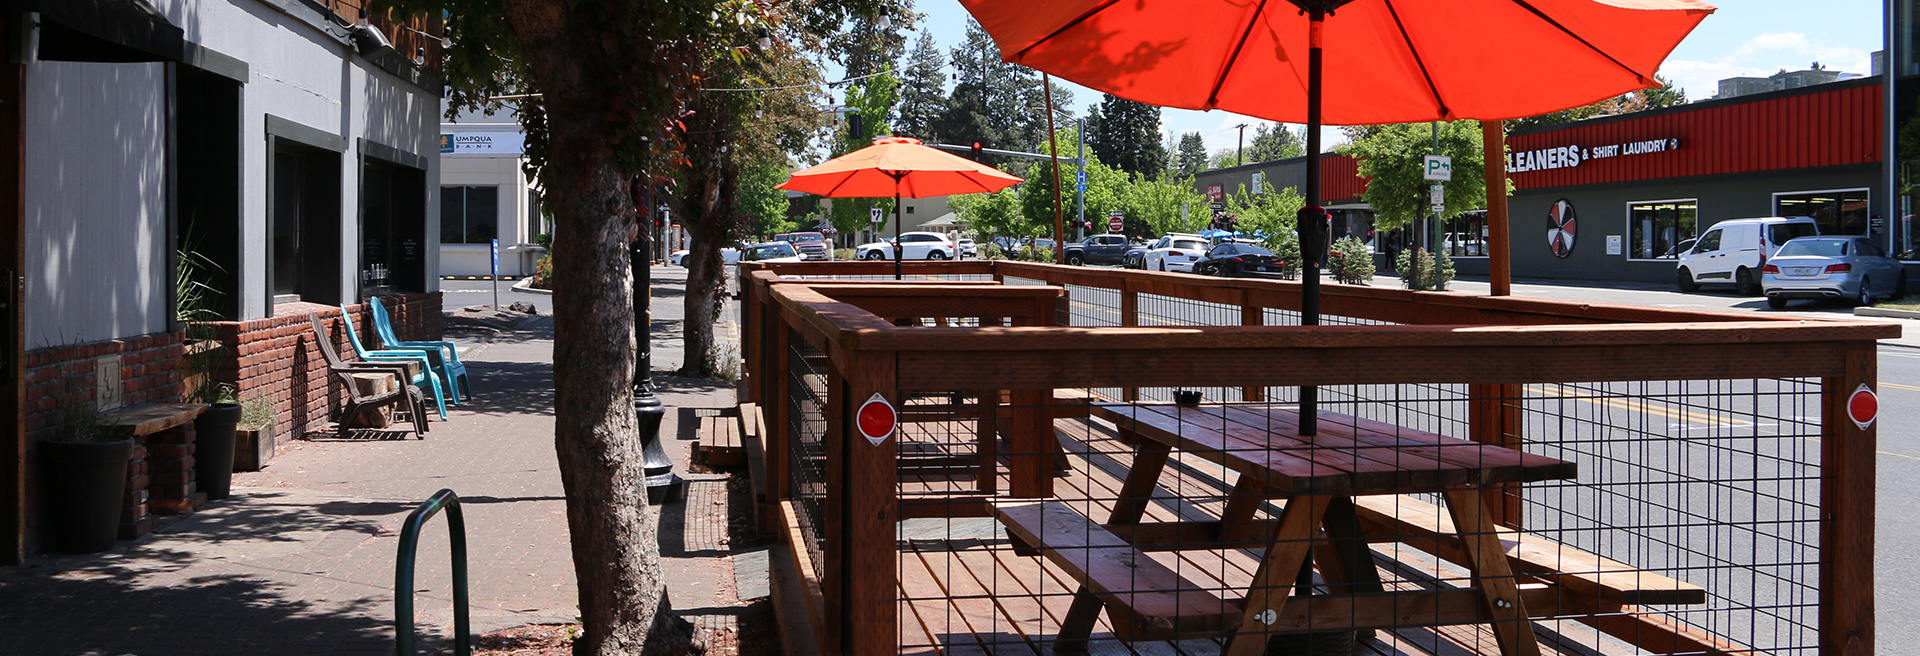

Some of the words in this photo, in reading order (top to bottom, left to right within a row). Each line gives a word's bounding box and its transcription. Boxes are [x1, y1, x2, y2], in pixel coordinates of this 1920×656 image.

[1504, 145, 1579, 173] LEANERS
[1582, 149, 1589, 160] &
[1593, 145, 1619, 159] SHIRT
[1623, 139, 1668, 155] LAUNDRY
[1077, 171, 1086, 182] H
